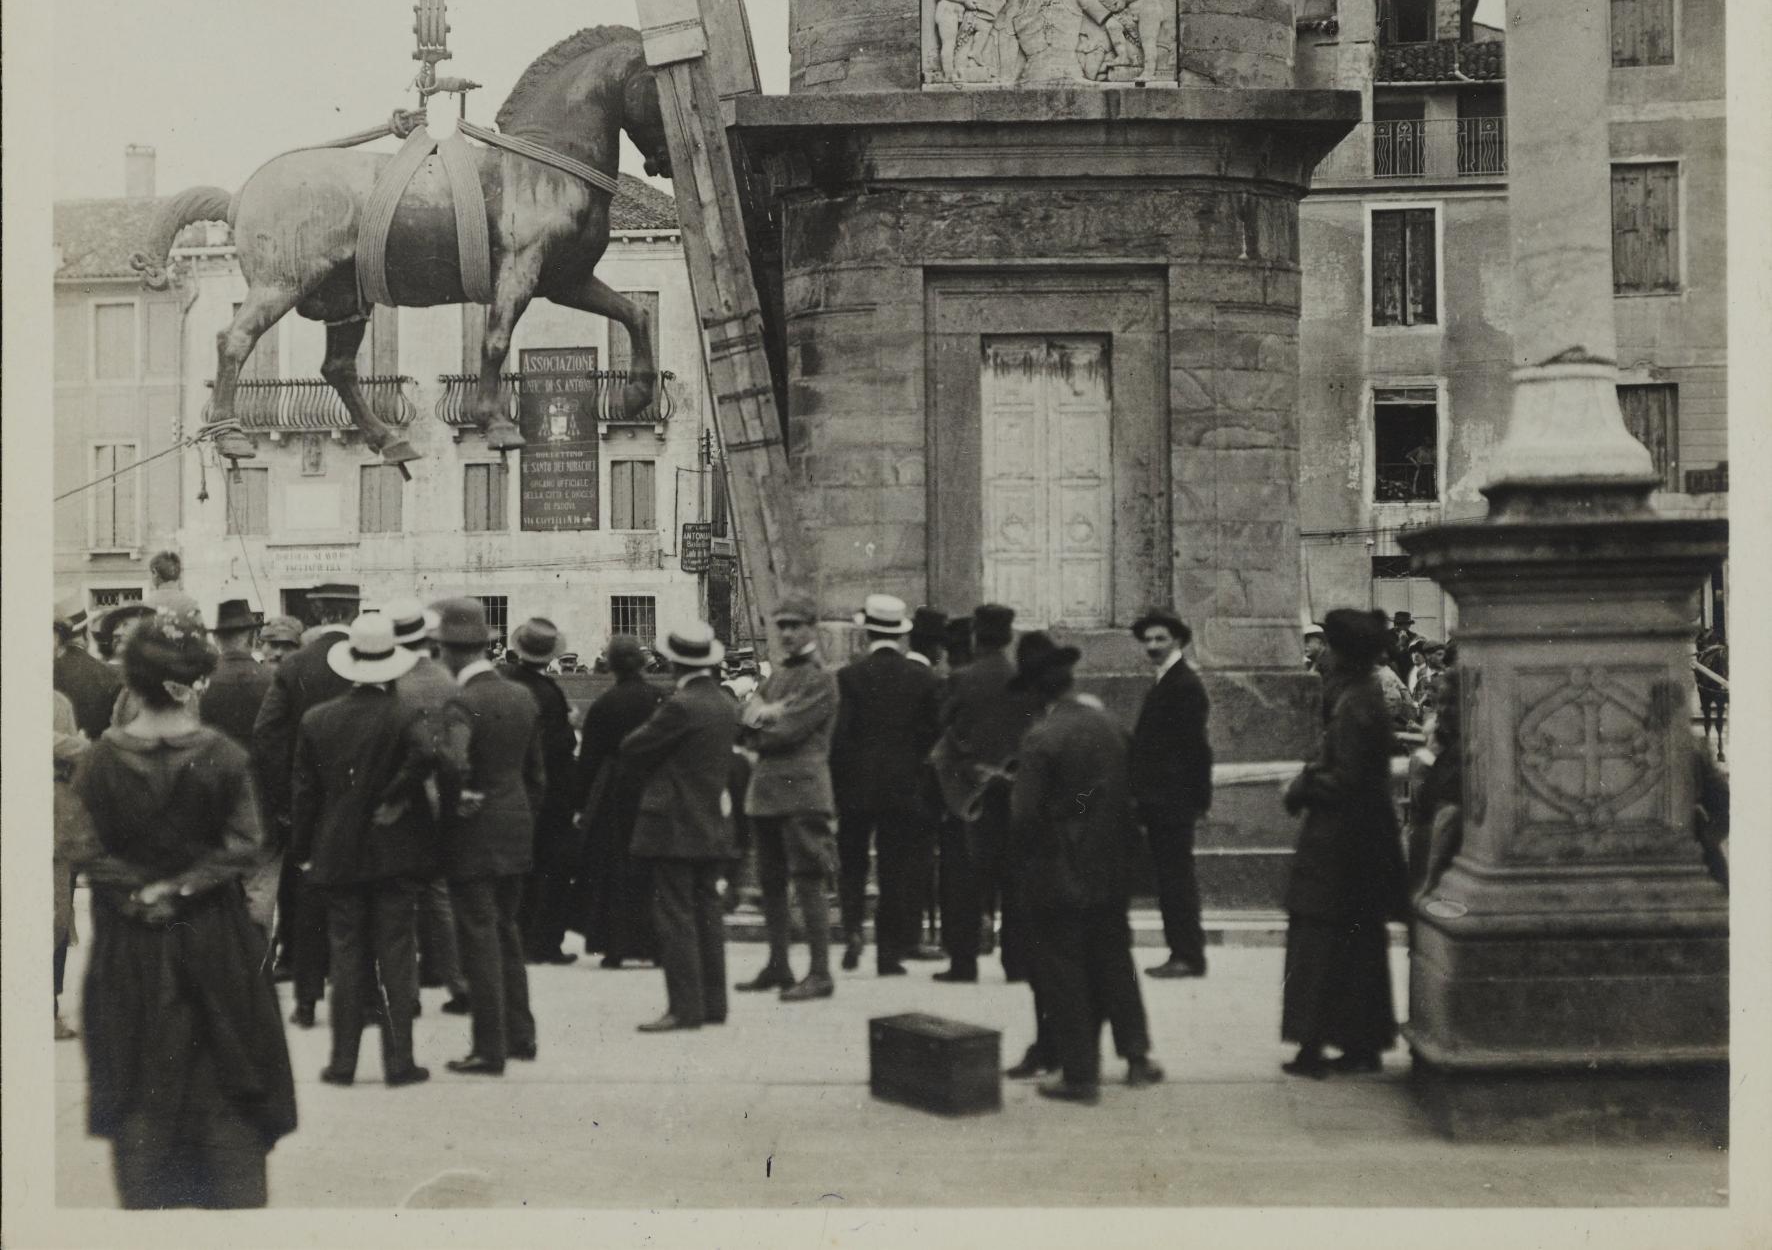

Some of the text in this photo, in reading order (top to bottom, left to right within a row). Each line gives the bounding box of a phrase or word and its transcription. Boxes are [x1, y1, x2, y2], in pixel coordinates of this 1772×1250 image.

[522, 353, 595, 373] ASSOCIAZIONE
[530, 461, 552, 473] SANTO
[556, 478, 589, 488] UFFICIALE
